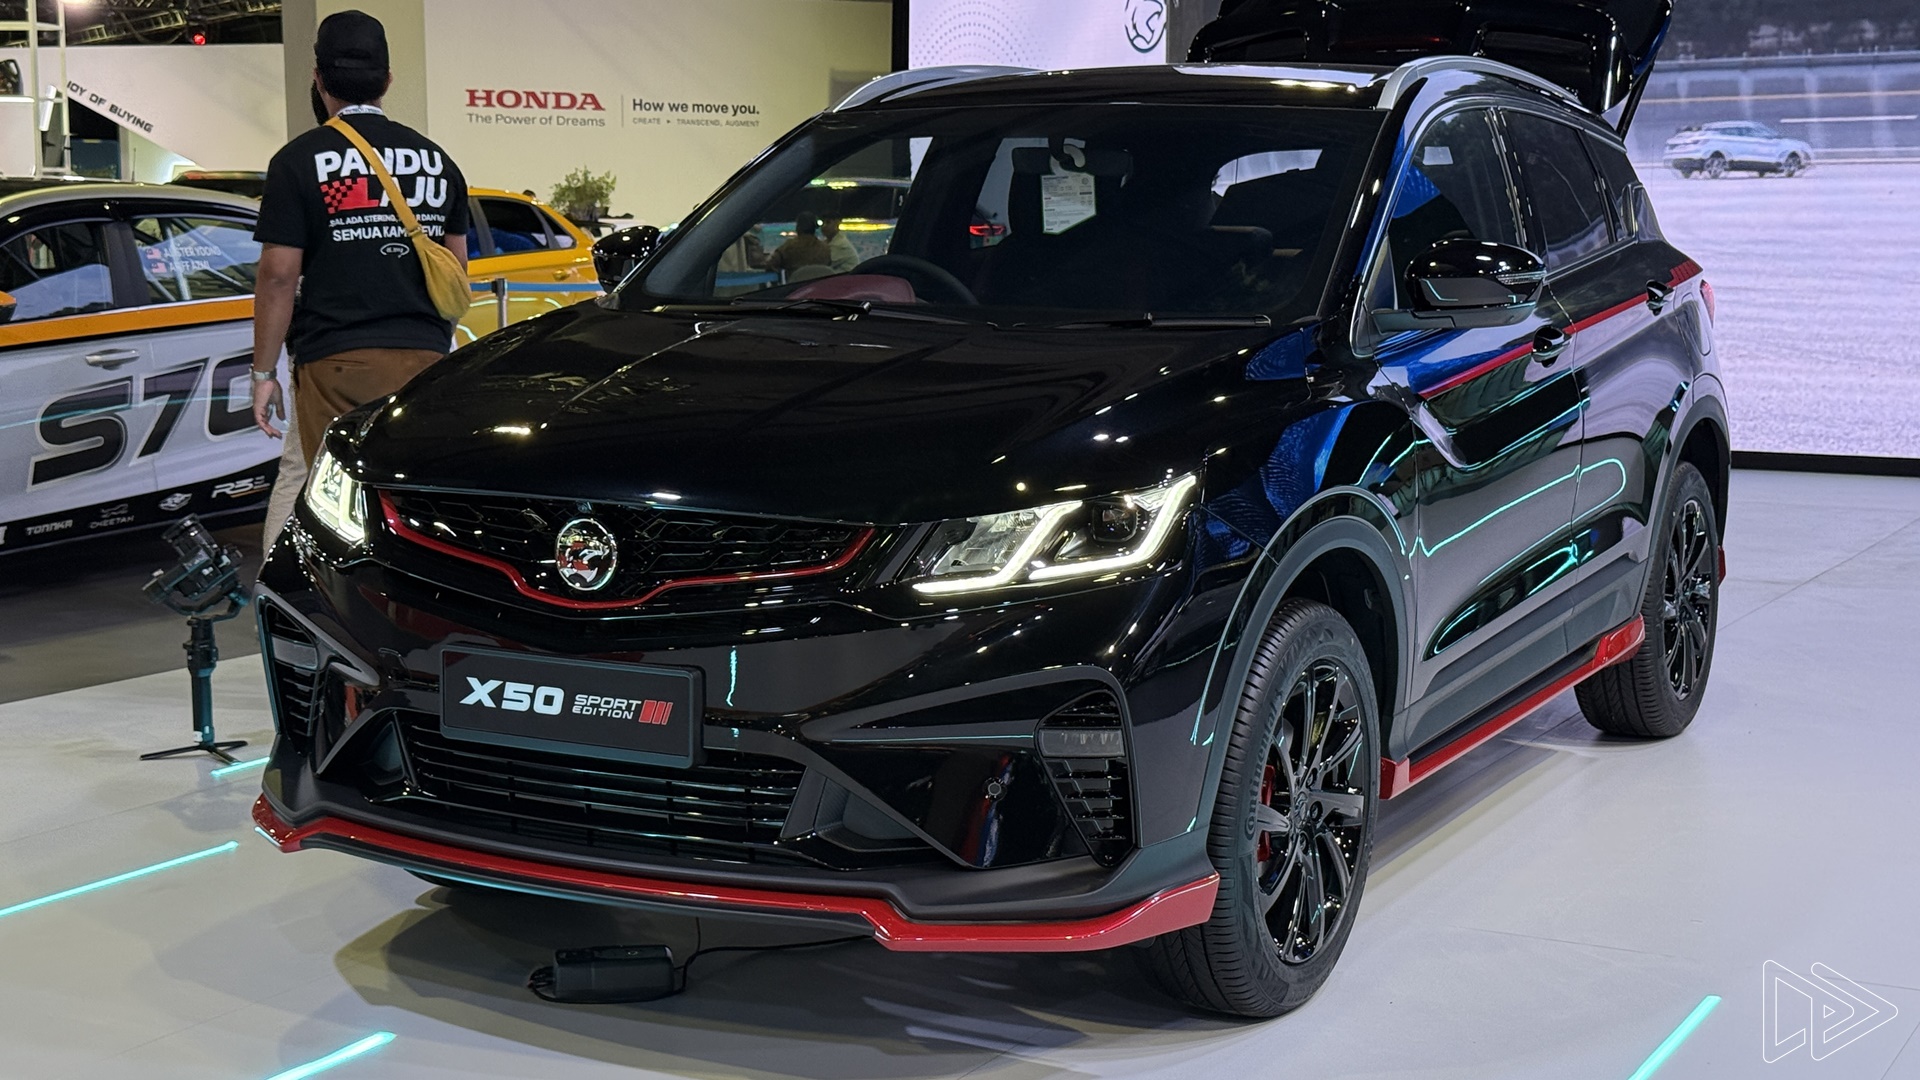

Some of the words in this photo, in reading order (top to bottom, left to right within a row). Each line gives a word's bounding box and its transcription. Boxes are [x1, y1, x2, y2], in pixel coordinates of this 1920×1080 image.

[465, 89, 606, 111] HONDA
[632, 98, 664, 112] How
[668, 102, 689, 113] we
[692, 103, 729, 114] move
[731, 104, 760, 117] you.
[89, 93, 107, 106] OF
[109, 103, 154, 133] BUYING
[467, 113, 492, 125] The
[495, 114, 537, 126] Power
[539, 115, 553, 126] of
[556, 115, 606, 127] Dreams
[632, 117, 661, 125] CREATE
[724, 119, 760, 127] AUGMENT
[314, 147, 443, 183] PANDU
[345, 215, 364, 225] ADA
[332, 226, 382, 242] SEMUA
[383, 225, 408, 238] KAM
[164, 247, 195, 258] ASTER
[170, 260, 191, 272] AFF
[459, 676, 564, 715] X50
[574, 694, 641, 710] SPORT
[572, 705, 633, 719] EDITION
